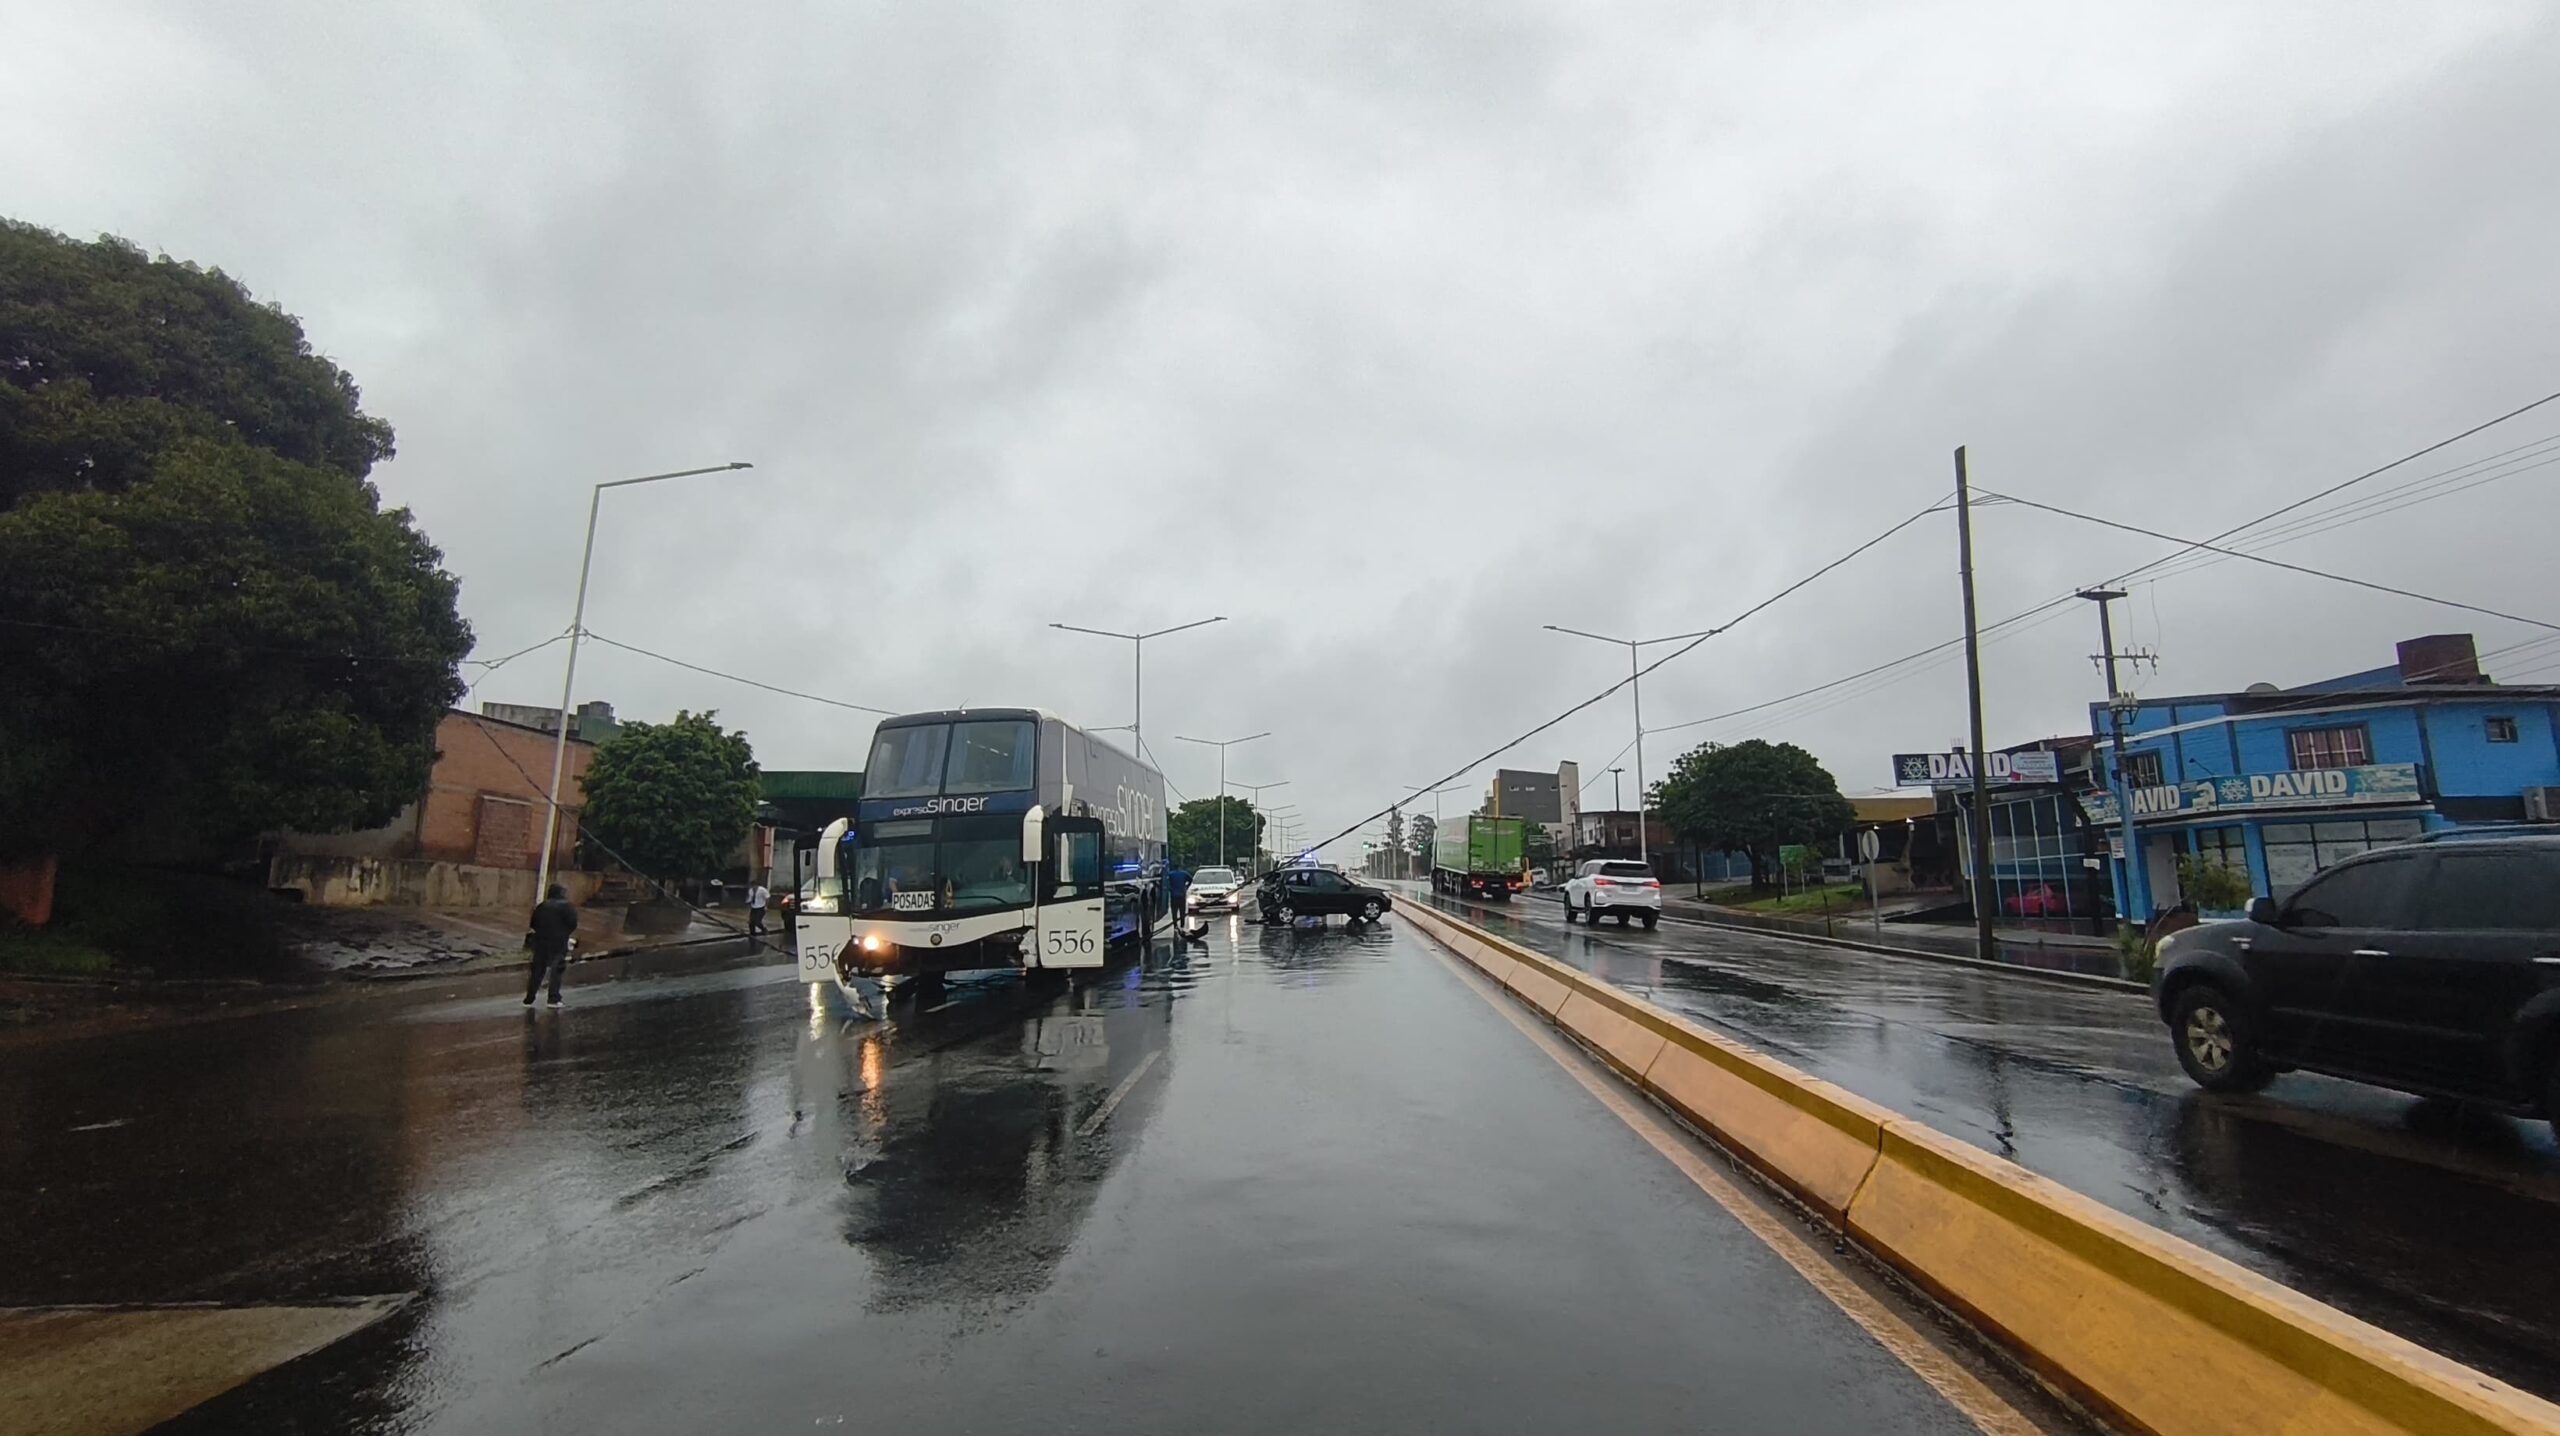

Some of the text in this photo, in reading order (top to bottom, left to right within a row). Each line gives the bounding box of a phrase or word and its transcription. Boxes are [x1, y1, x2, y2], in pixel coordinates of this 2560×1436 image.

[2251, 770, 2347, 797] DAVID
[927, 796, 989, 814] singer
[2129, 785, 2180, 814] AVID
[1117, 775, 1154, 860] singer
[893, 893, 936, 909] POSADAS
[1047, 928, 1094, 954] 556
